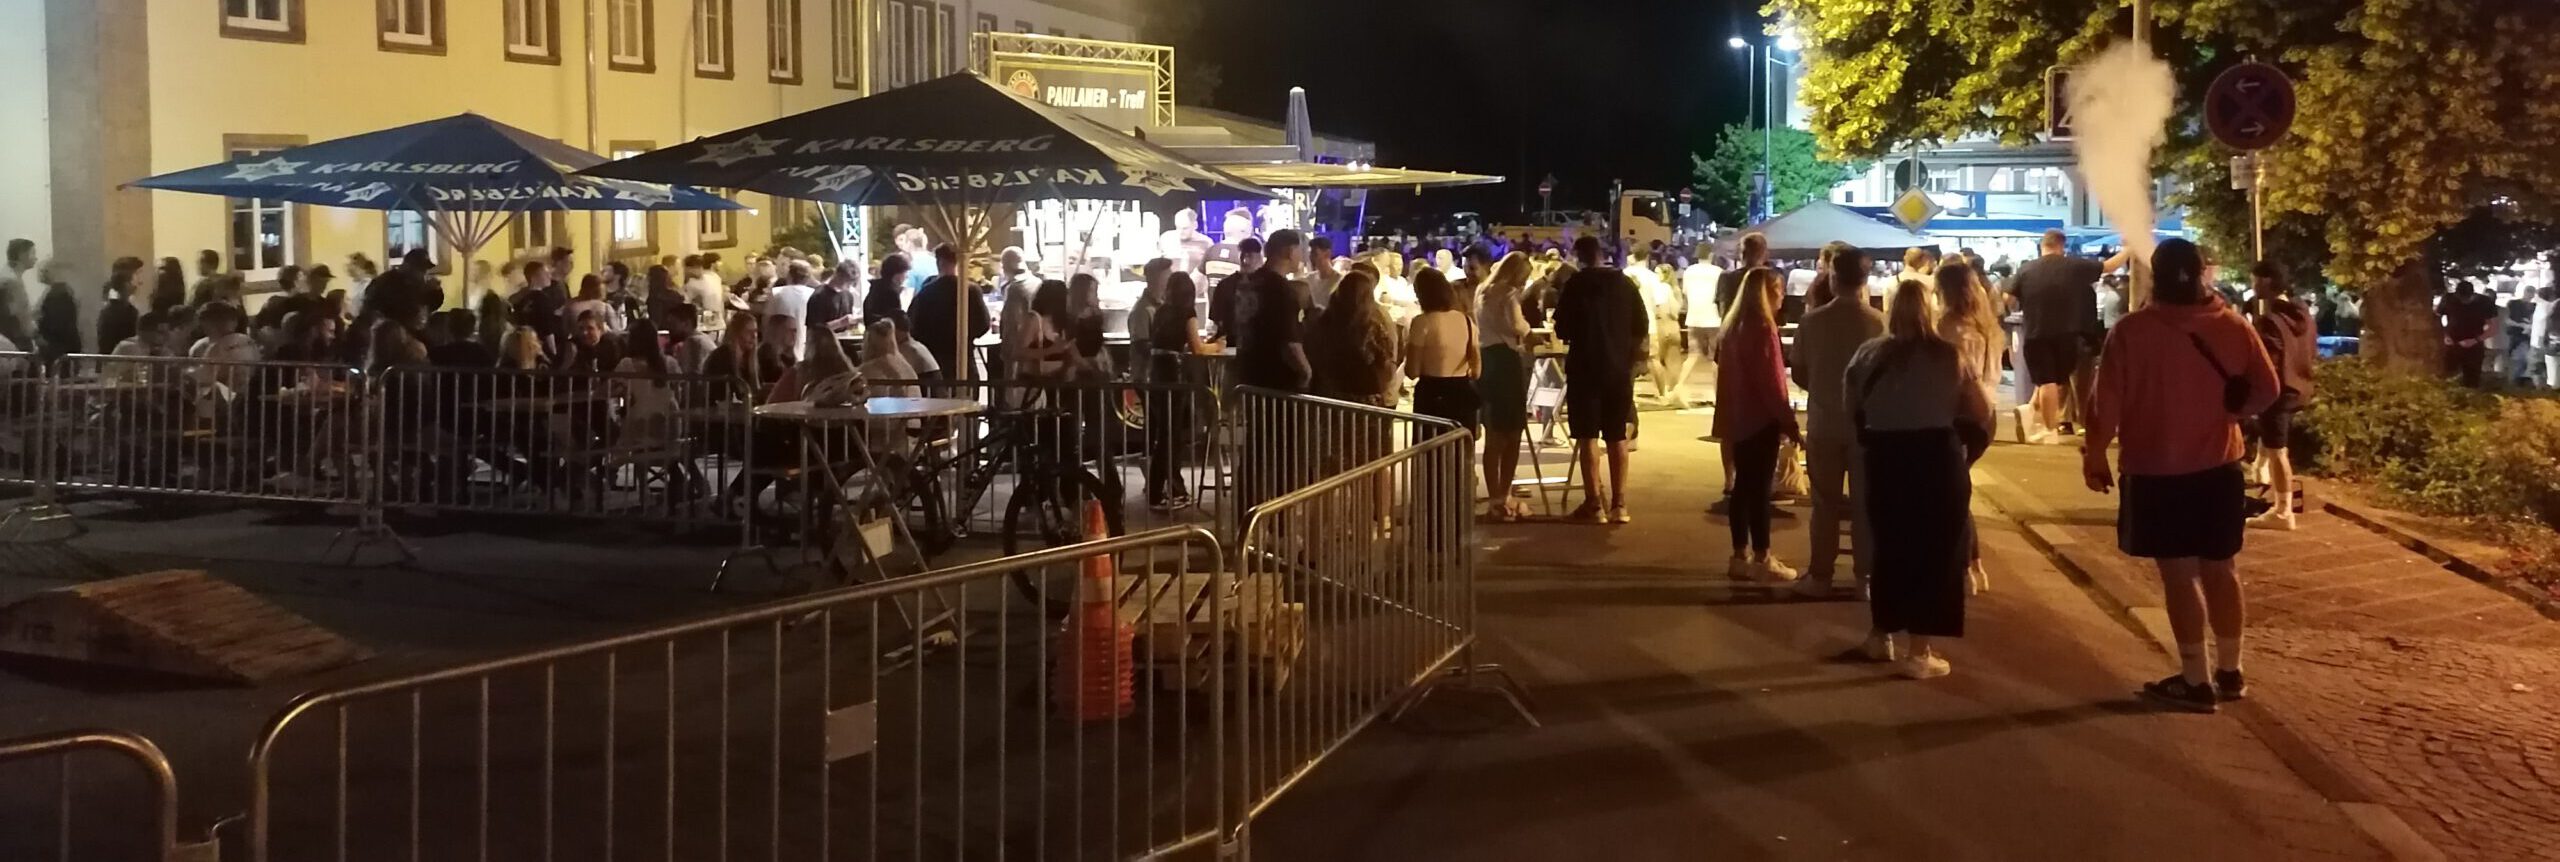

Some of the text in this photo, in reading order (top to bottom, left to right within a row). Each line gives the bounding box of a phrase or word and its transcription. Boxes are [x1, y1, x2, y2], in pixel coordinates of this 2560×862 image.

[1047, 86, 1108, 107] PAULANER
[793, 135, 1054, 155] KARLSBERG
[310, 160, 521, 174] KARLSBERG
